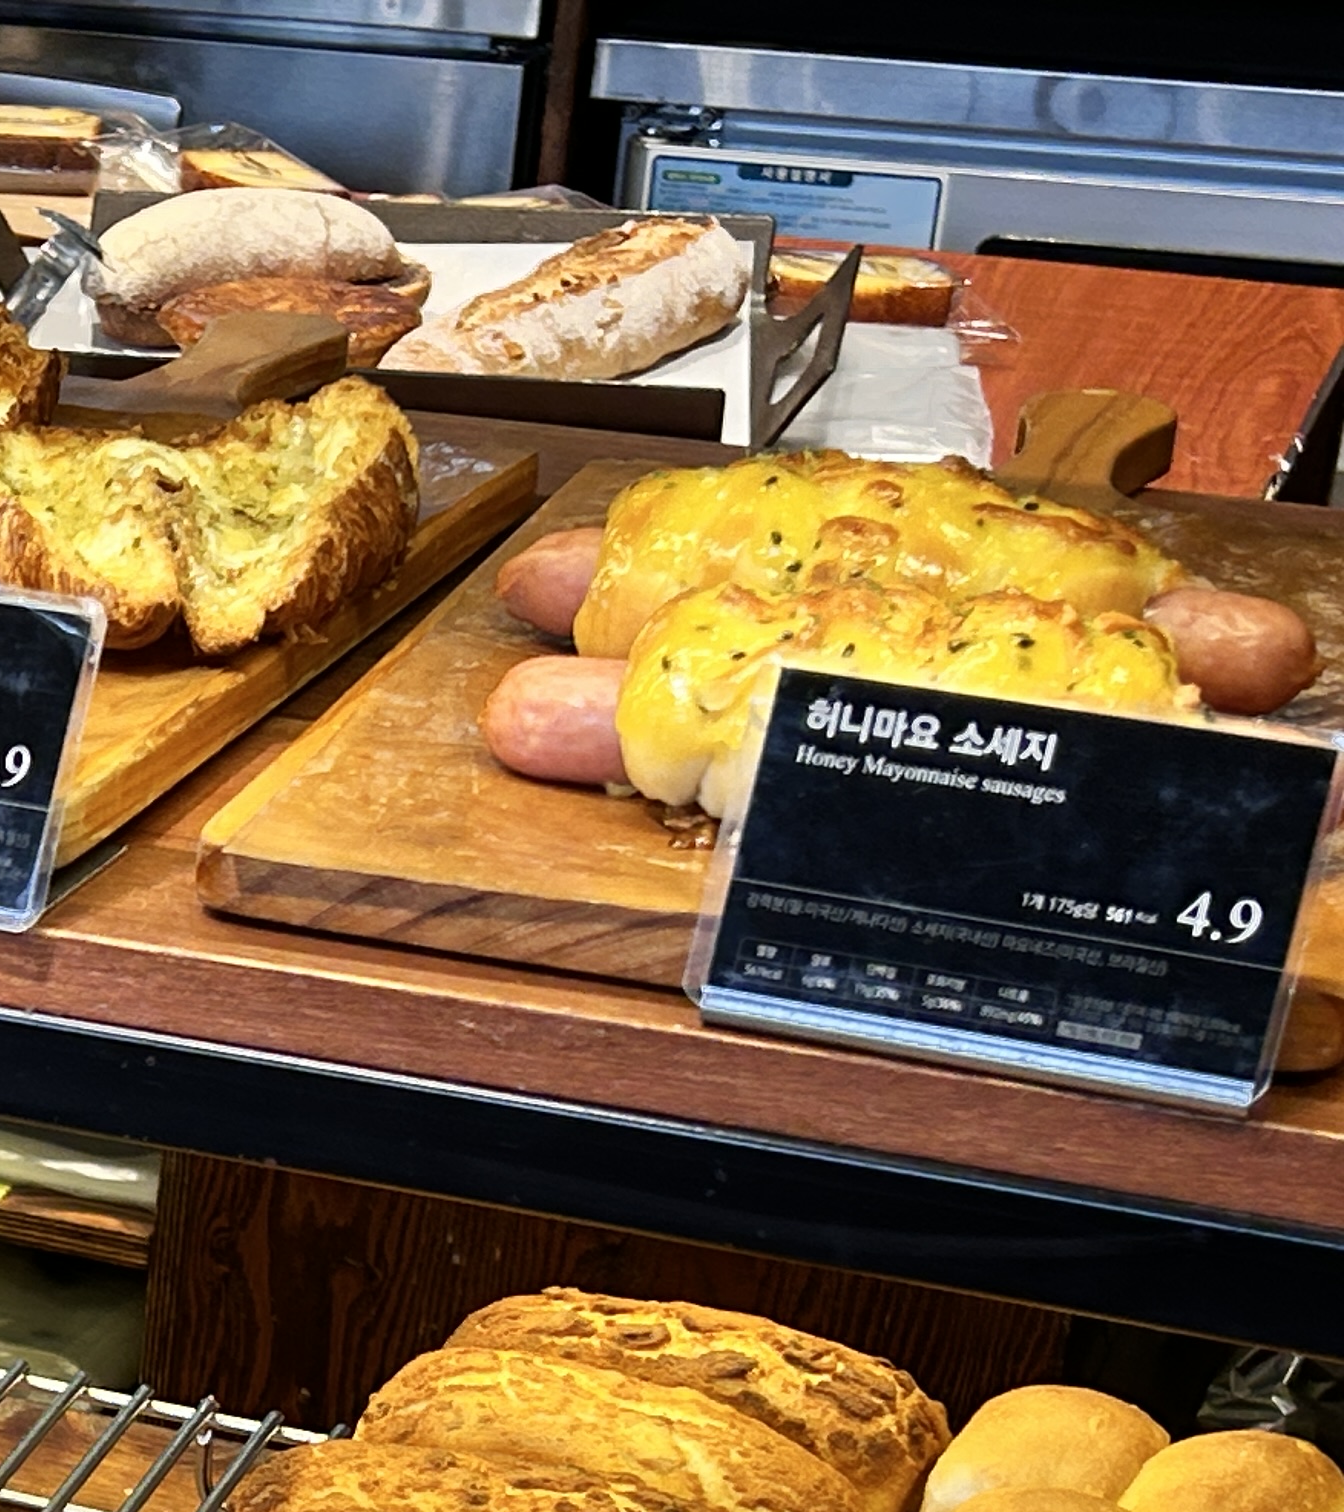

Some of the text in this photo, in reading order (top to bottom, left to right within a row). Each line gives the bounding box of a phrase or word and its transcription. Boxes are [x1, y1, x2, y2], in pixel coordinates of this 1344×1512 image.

[806, 698, 1058, 771] 허니마요 소세지
[795, 744, 1066, 805] Honey Mayonnaise sausages
[1022, 892, 1045, 910] 1개
[1176, 891, 1263, 943] 4.9
